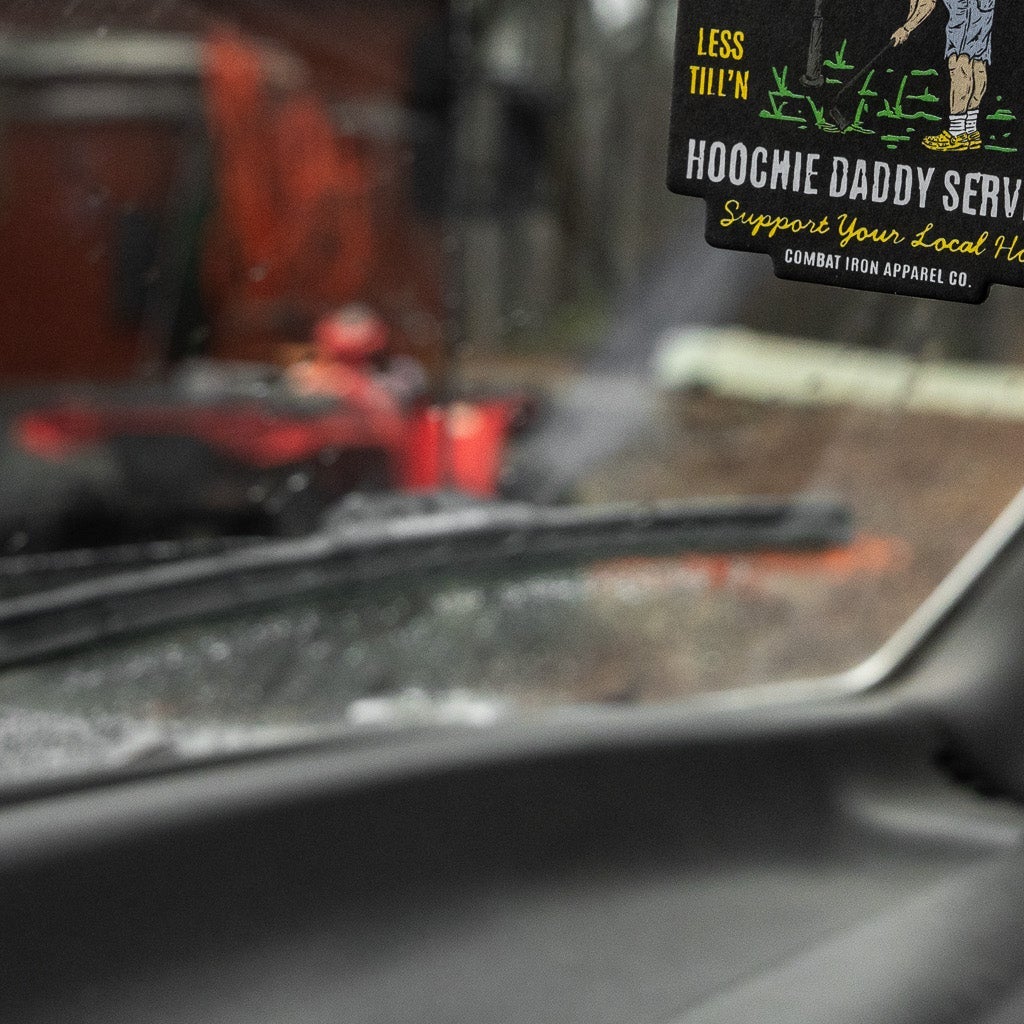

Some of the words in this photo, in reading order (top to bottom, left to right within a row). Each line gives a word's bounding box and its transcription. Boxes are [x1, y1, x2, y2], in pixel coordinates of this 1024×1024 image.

[697, 27, 745, 60] LESS
[689, 65, 750, 100] TILL'N
[686, 138, 820, 197] HOOCHIE
[829, 155, 936, 209] DADDY
[720, 199, 830, 240] Support
[836, 213, 905, 251] Your
[910, 222, 987, 256] Local
[784, 249, 841, 270] COMBAT
[845, 256, 879, 274] IRON
[883, 261, 944, 284] APPAREL
[948, 271, 972, 288] CO.
